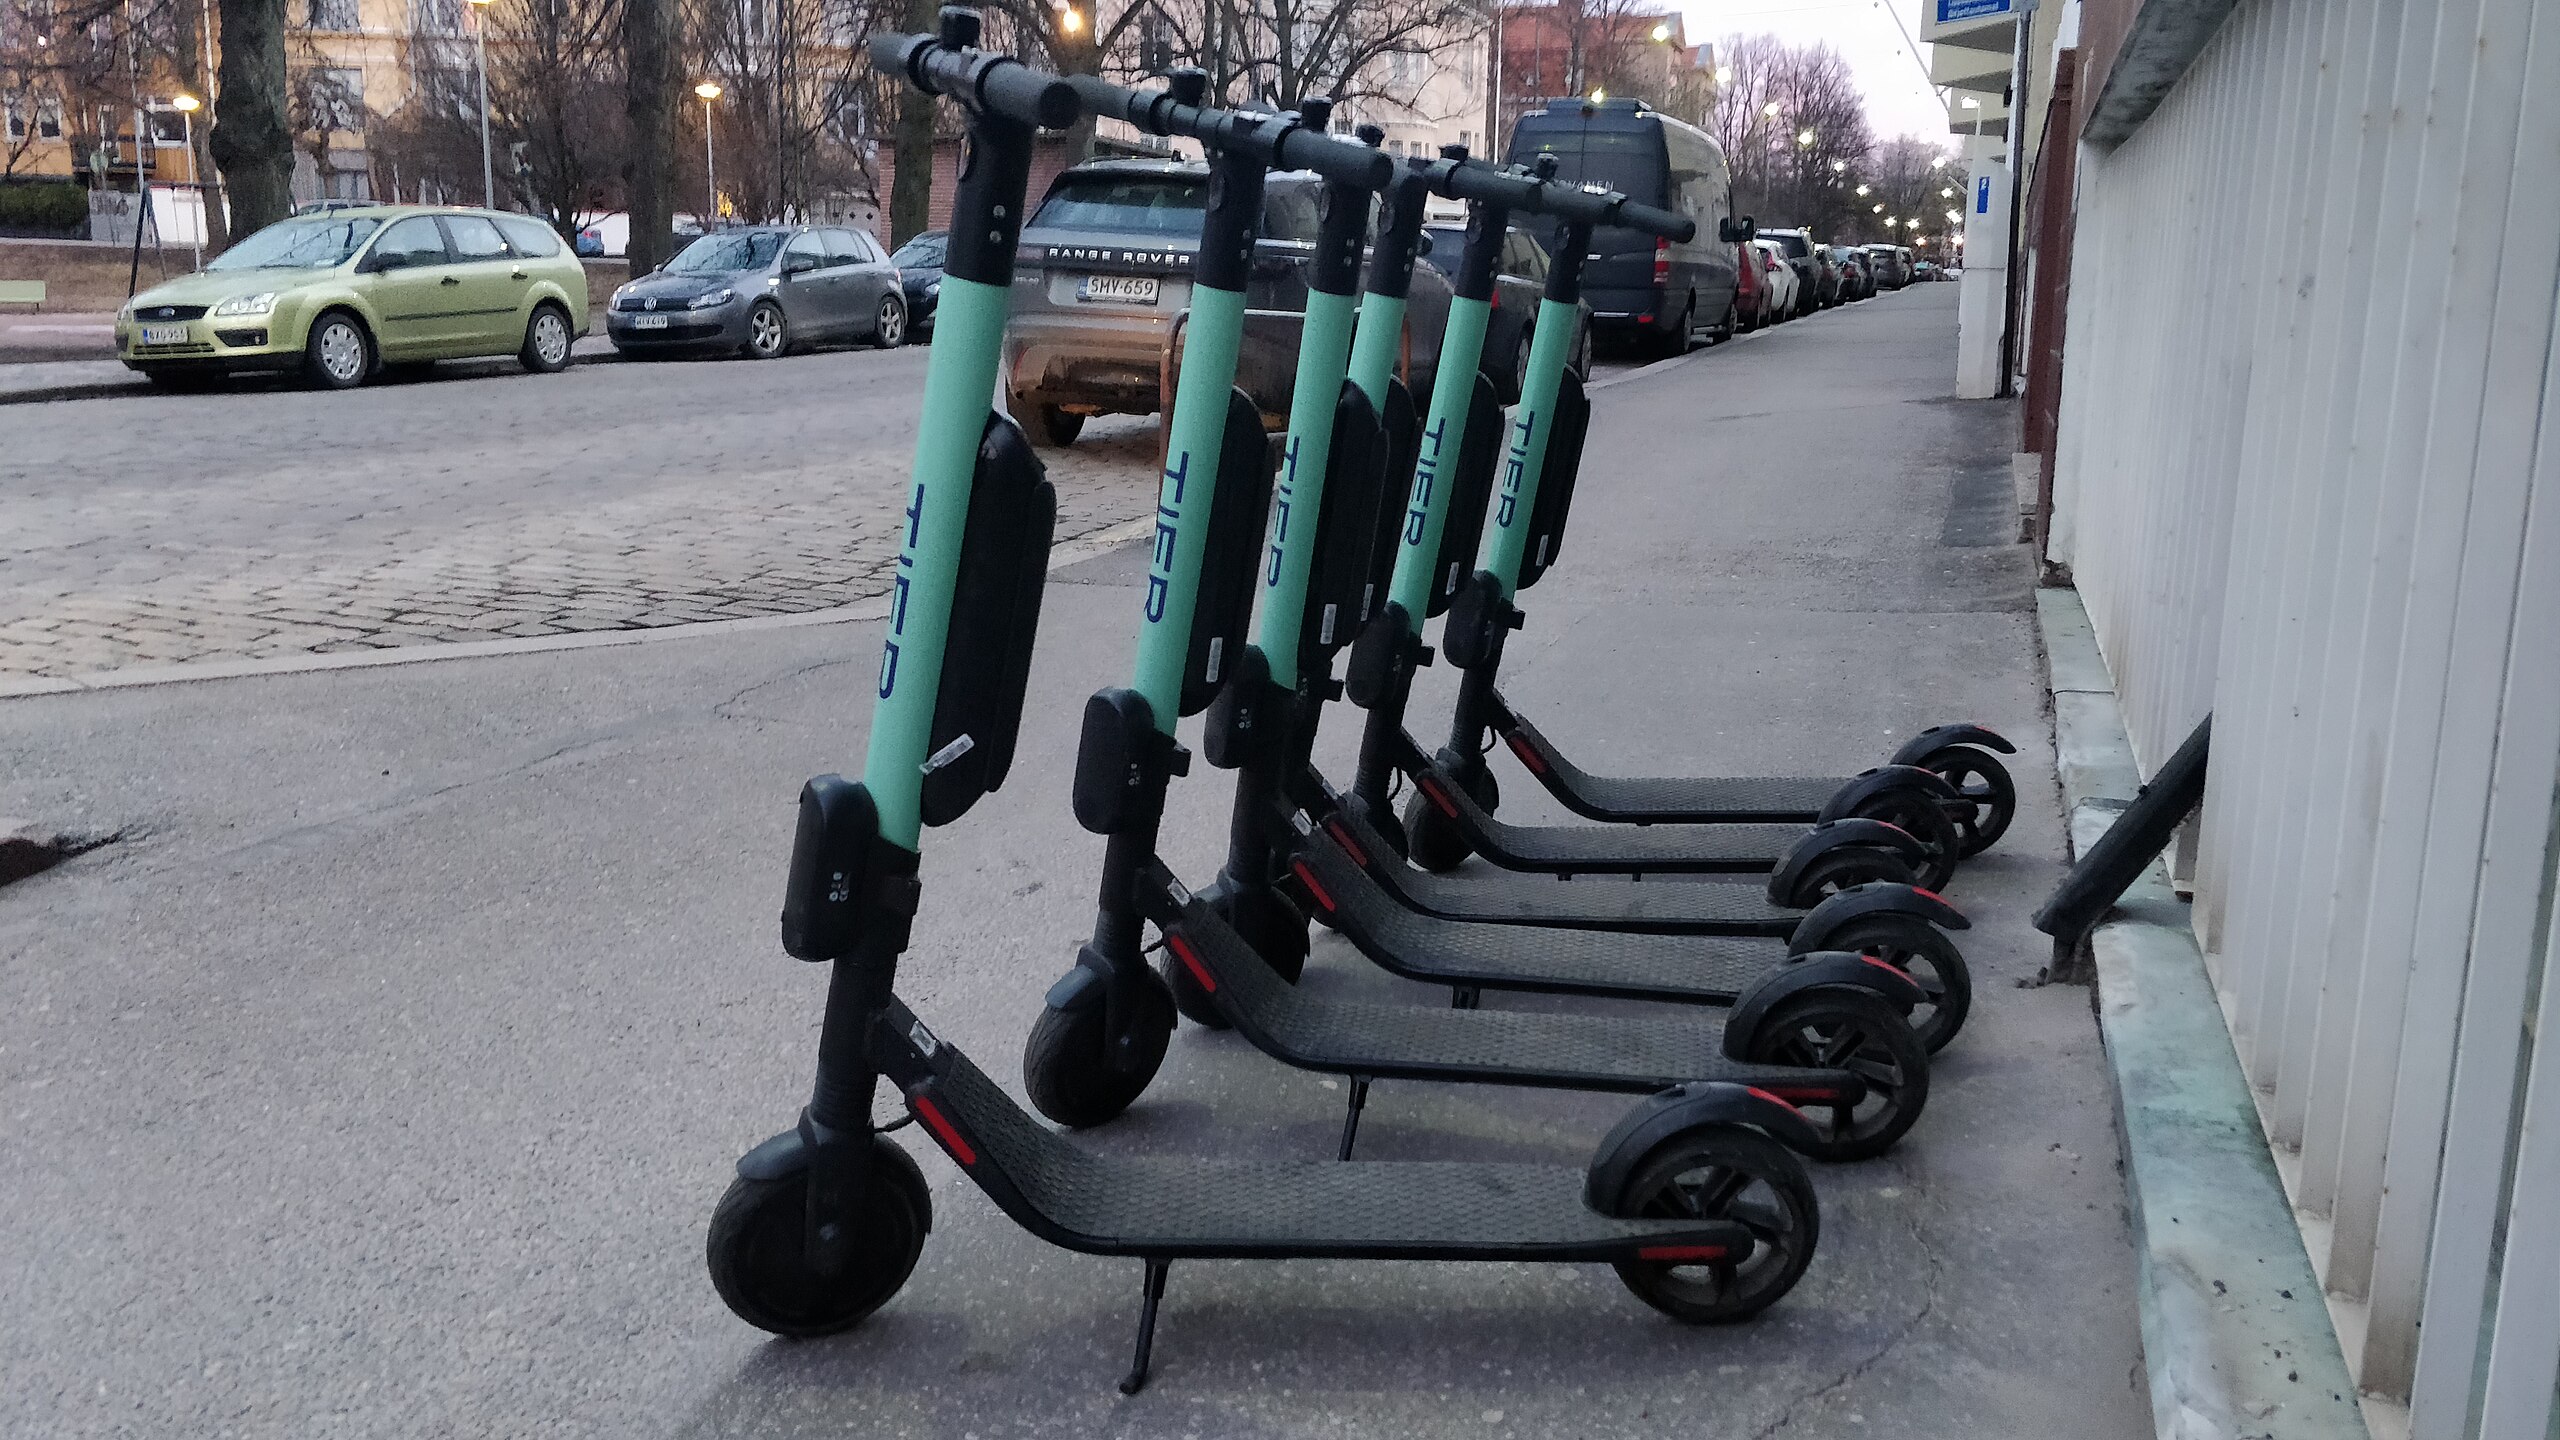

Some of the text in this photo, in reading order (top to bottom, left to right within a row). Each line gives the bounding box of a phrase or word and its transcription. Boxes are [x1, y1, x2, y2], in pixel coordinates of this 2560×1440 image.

[1049, 248, 1190, 265] RANGE ROVER
[1402, 417, 1446, 546] TIER
[1490, 410, 1535, 529] TIER
[1143, 450, 1190, 623] TIER
